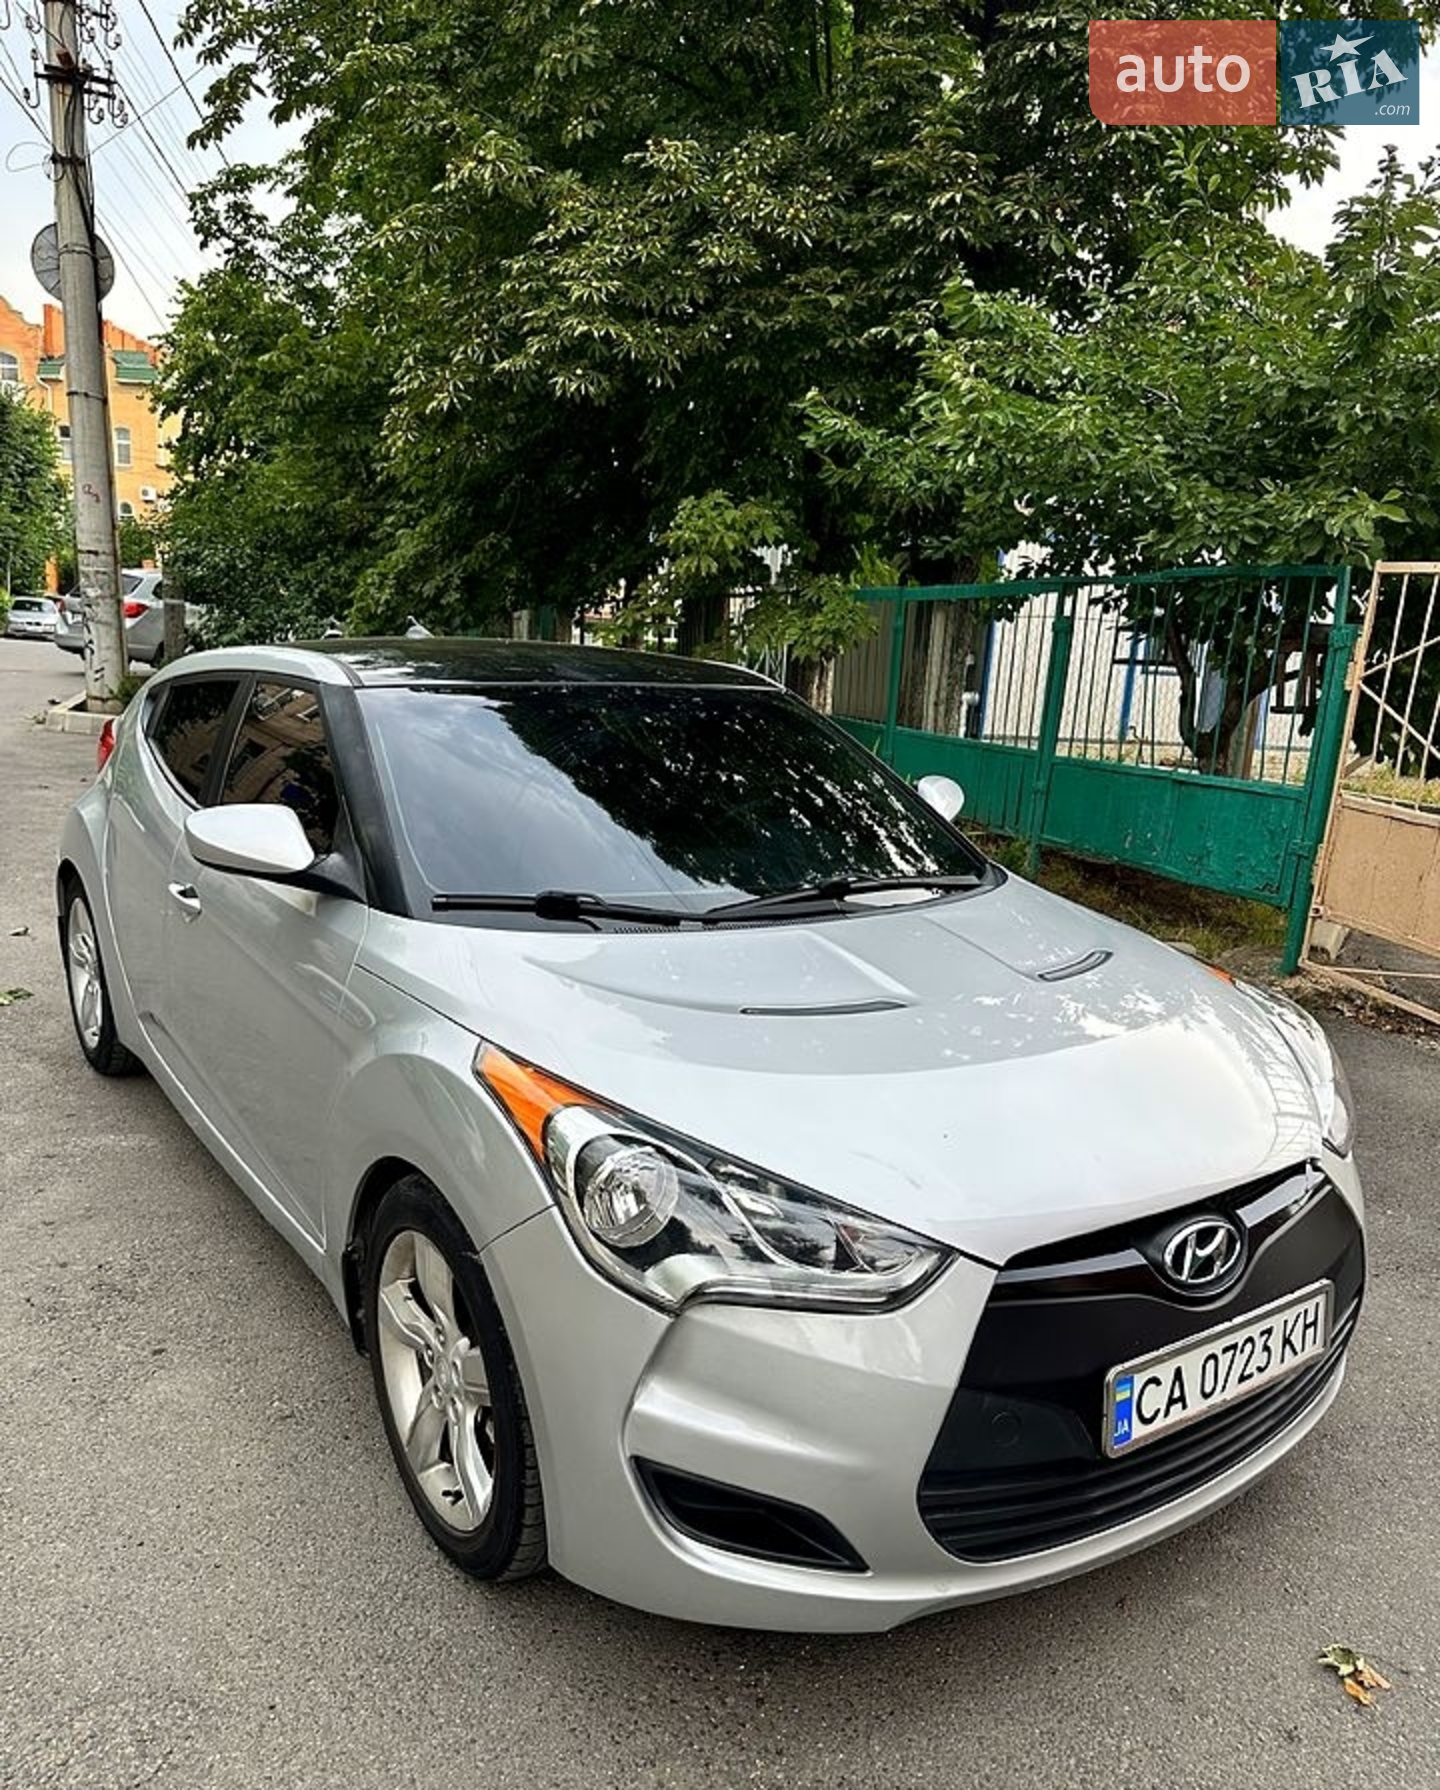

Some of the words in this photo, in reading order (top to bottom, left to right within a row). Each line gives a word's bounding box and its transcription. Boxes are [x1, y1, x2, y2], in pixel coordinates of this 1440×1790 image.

[1136, 1365, 1188, 1425] CA
[1200, 1325, 1274, 1400] 0723
[1280, 1301, 1320, 1364] KH
